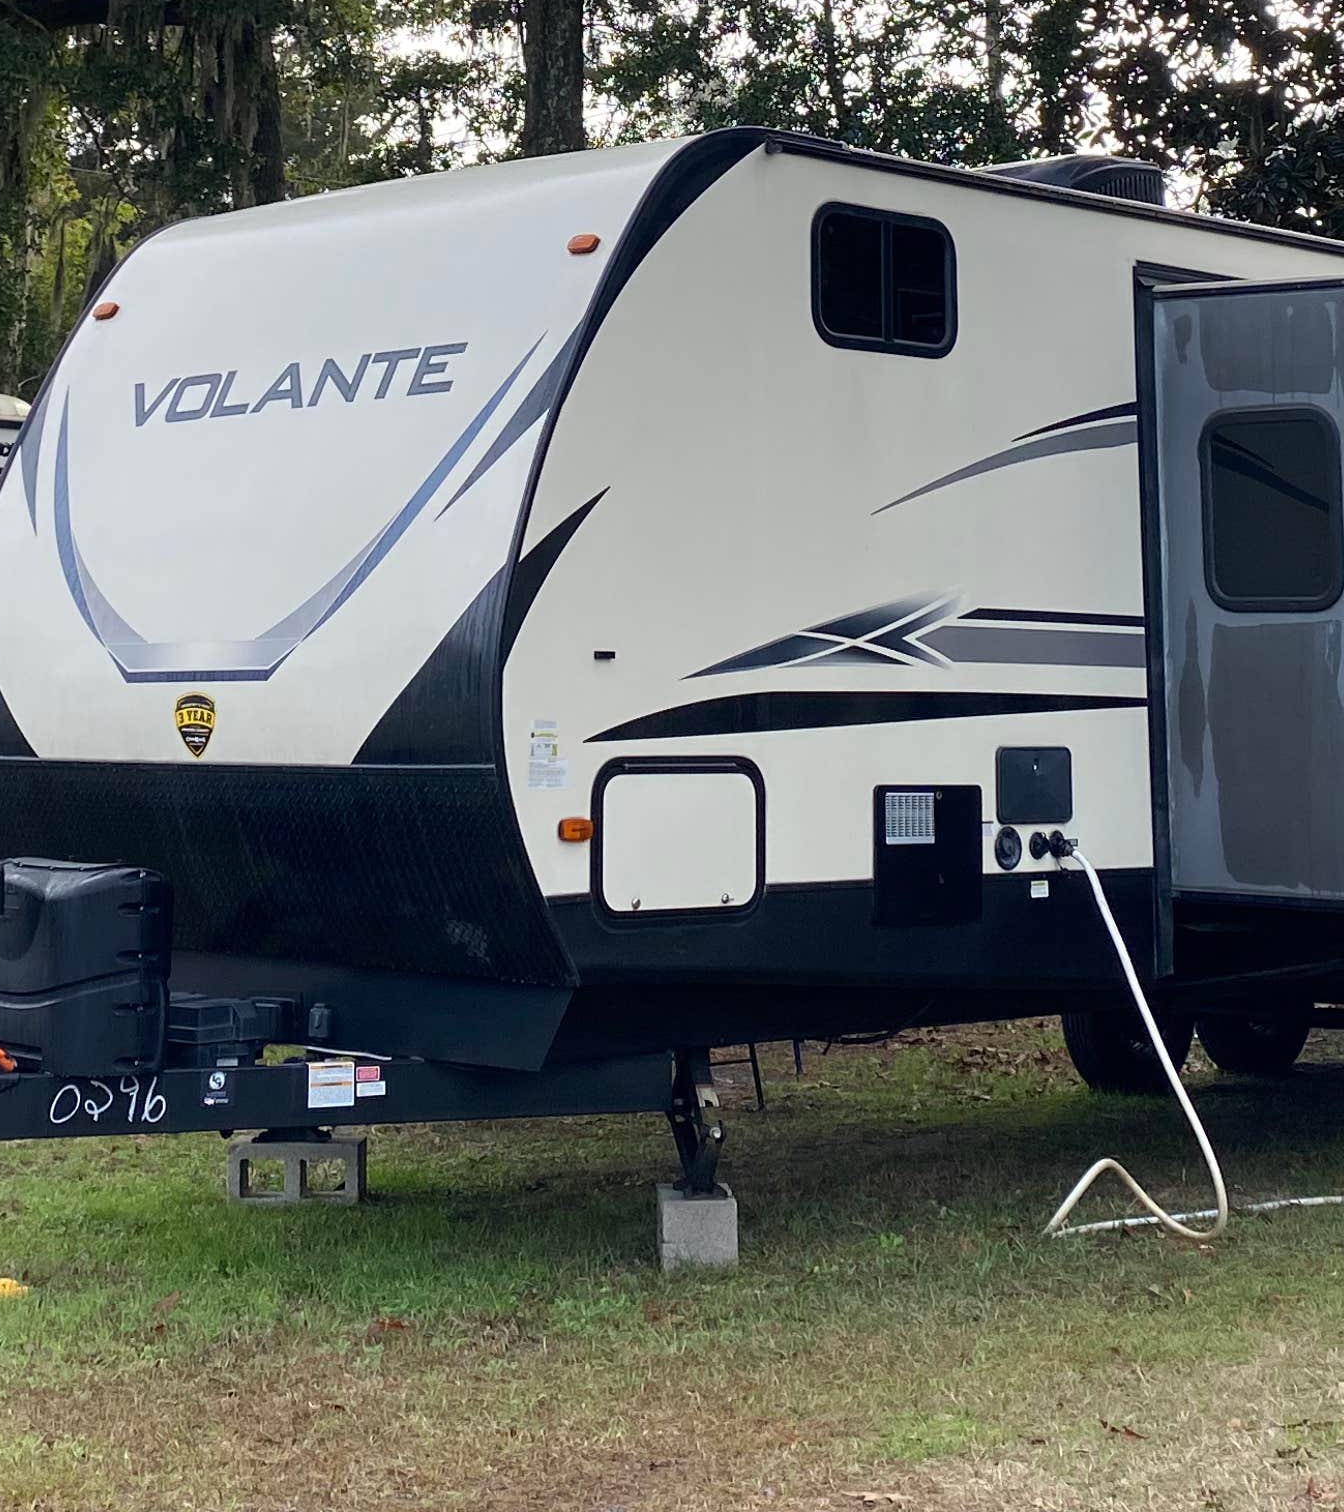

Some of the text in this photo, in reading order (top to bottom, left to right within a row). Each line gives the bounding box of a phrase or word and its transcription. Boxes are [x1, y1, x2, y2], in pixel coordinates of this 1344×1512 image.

[134, 342, 468, 427] VOLANTE
[178, 710, 212, 725] 3 YEAR
